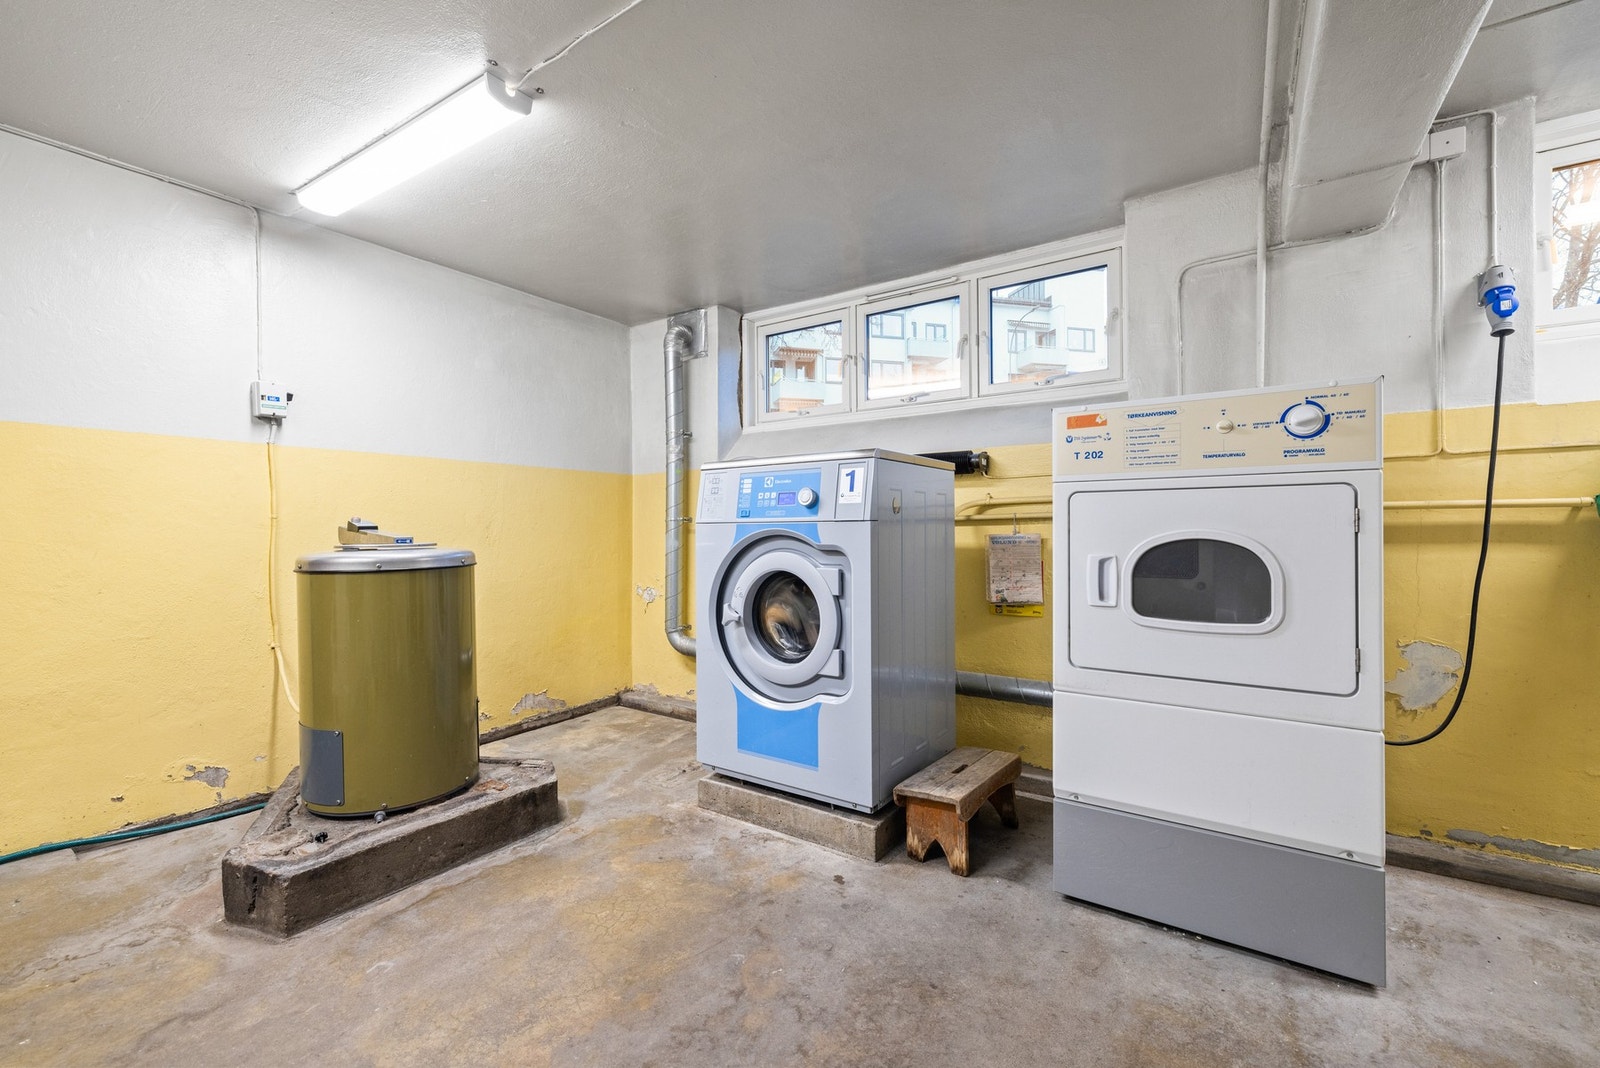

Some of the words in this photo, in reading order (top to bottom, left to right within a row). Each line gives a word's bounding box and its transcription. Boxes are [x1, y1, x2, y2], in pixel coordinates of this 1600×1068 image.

[1127, 410, 1177, 419] TØRKEANVISNING
[1074, 452, 1080, 460] T
[1084, 450, 1104, 459] 202
[846, 470, 855, 492] 1
